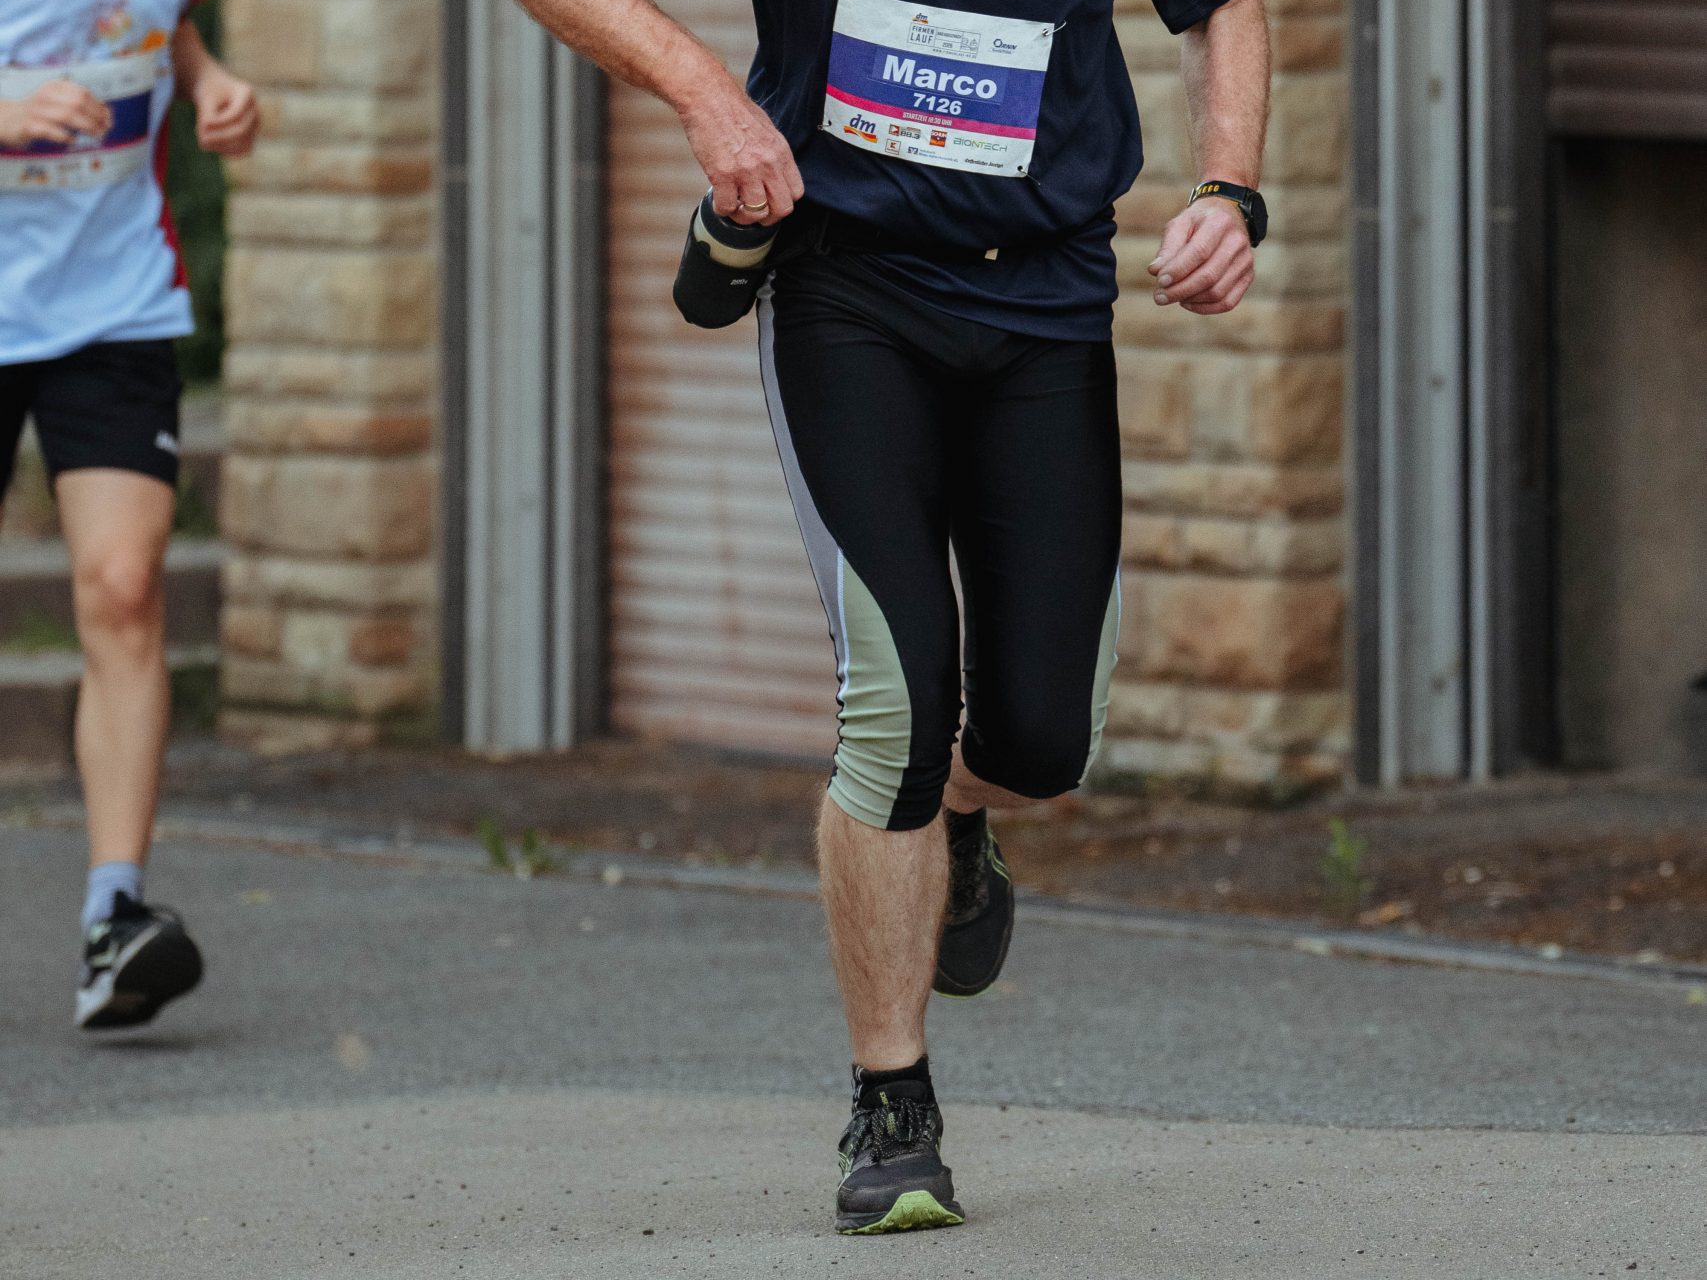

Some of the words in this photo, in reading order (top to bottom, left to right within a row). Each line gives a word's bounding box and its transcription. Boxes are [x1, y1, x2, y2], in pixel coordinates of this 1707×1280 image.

[910, 32, 933, 44] LAUF
[912, 25, 935, 35] FIRMEN
[882, 54, 997, 99] Marco
[913, 92, 962, 115] 7126
[849, 114, 876, 134] dm
[900, 130, 920, 140] 88.3
[953, 137, 1008, 153] BIONTECH
